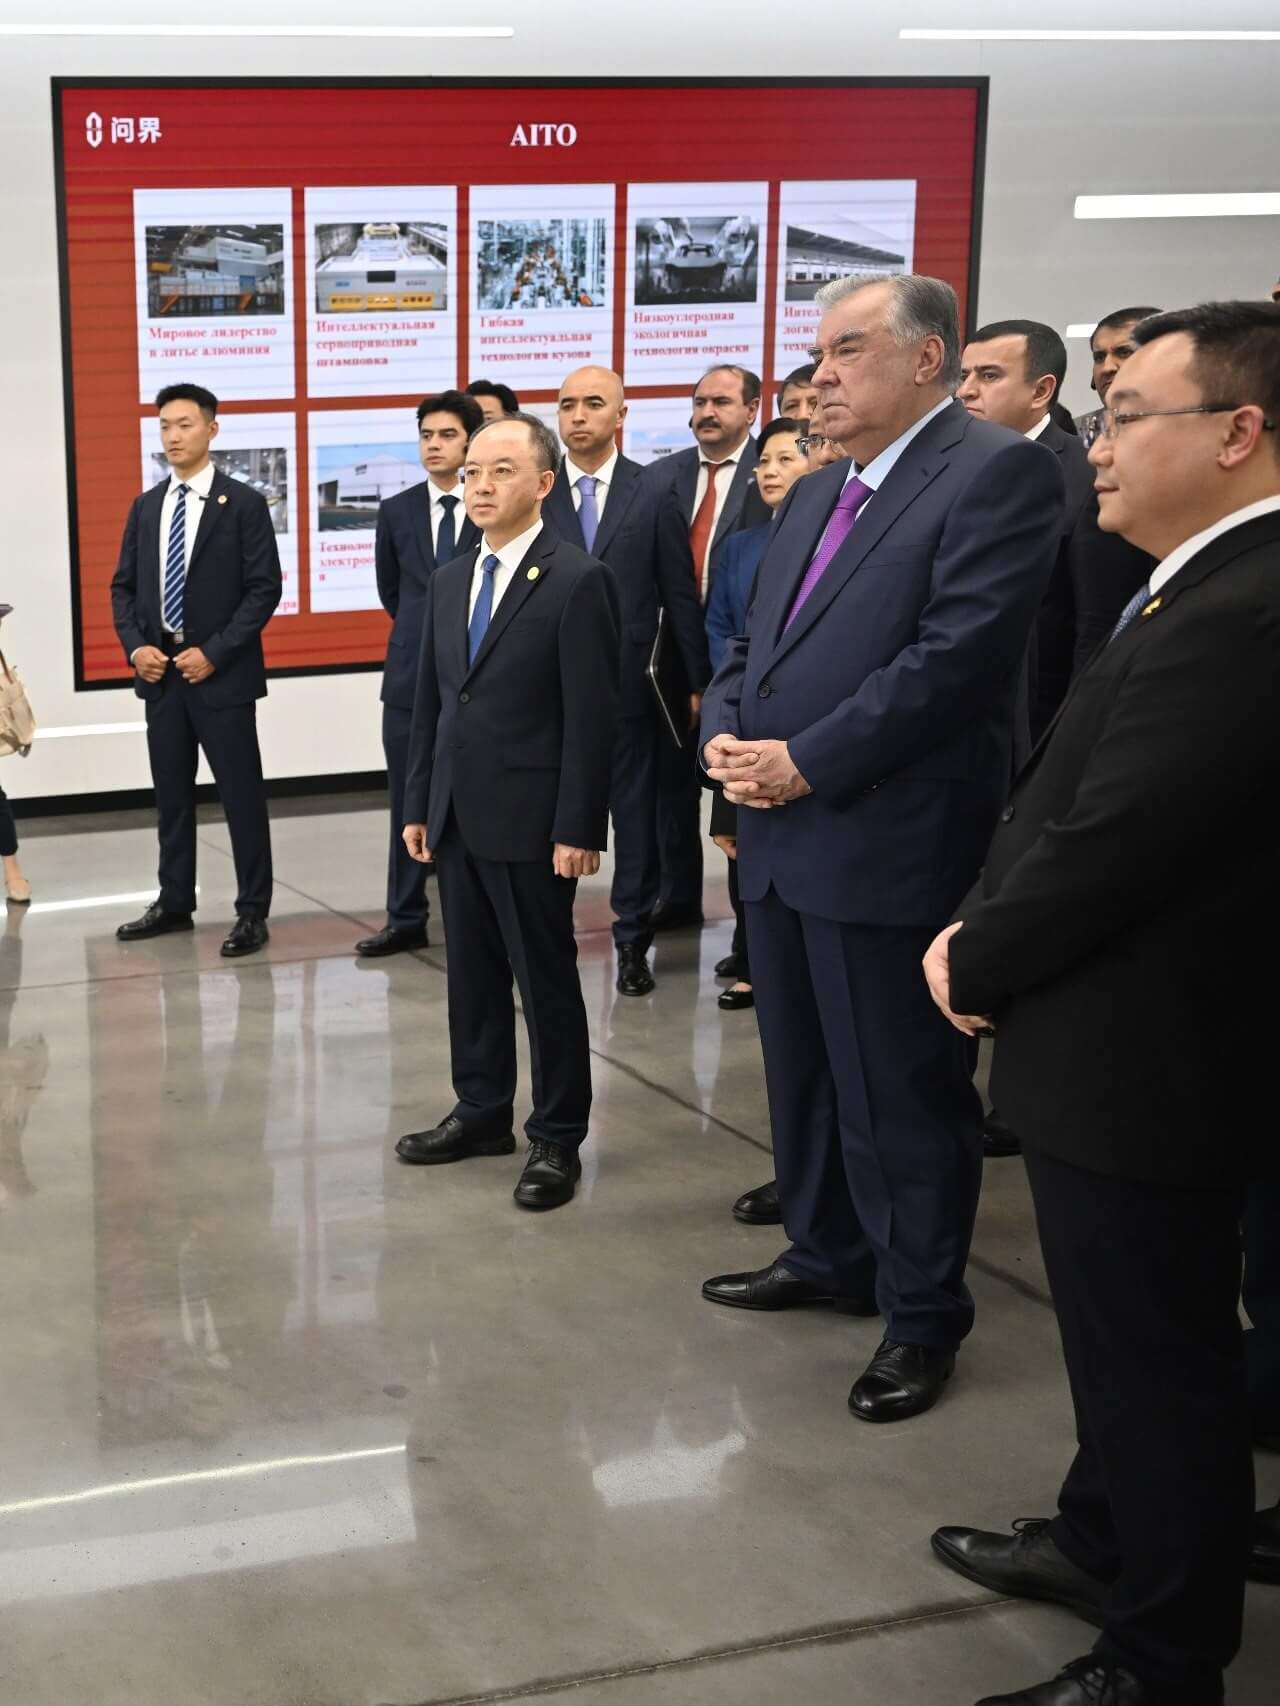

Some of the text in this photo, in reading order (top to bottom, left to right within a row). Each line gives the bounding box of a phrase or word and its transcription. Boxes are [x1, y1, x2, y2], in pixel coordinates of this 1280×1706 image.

[111, 116, 162, 144] 问界
[510, 123, 577, 147] AITO
[634, 311, 735, 324] Низкоуглеродная
[784, 306, 821, 319] Интел
[316, 321, 435, 334] Интеллектуальная
[480, 315, 524, 329] Гибкая
[149, 327, 277, 342] Мировое лидерство
[634, 329, 708, 340] экологичная
[783, 325, 815, 336] логис
[480, 332, 593, 346] интеллектуальная
[161, 347, 199, 358] литье
[202, 345, 271, 356] алюминия
[316, 339, 418, 353] сервоприводная
[634, 344, 750, 357] технология окраски
[784, 343, 812, 352] техн
[480, 350, 592, 362] технология кузова
[316, 358, 389, 368] штамповка
[320, 542, 373, 552] Технолог
